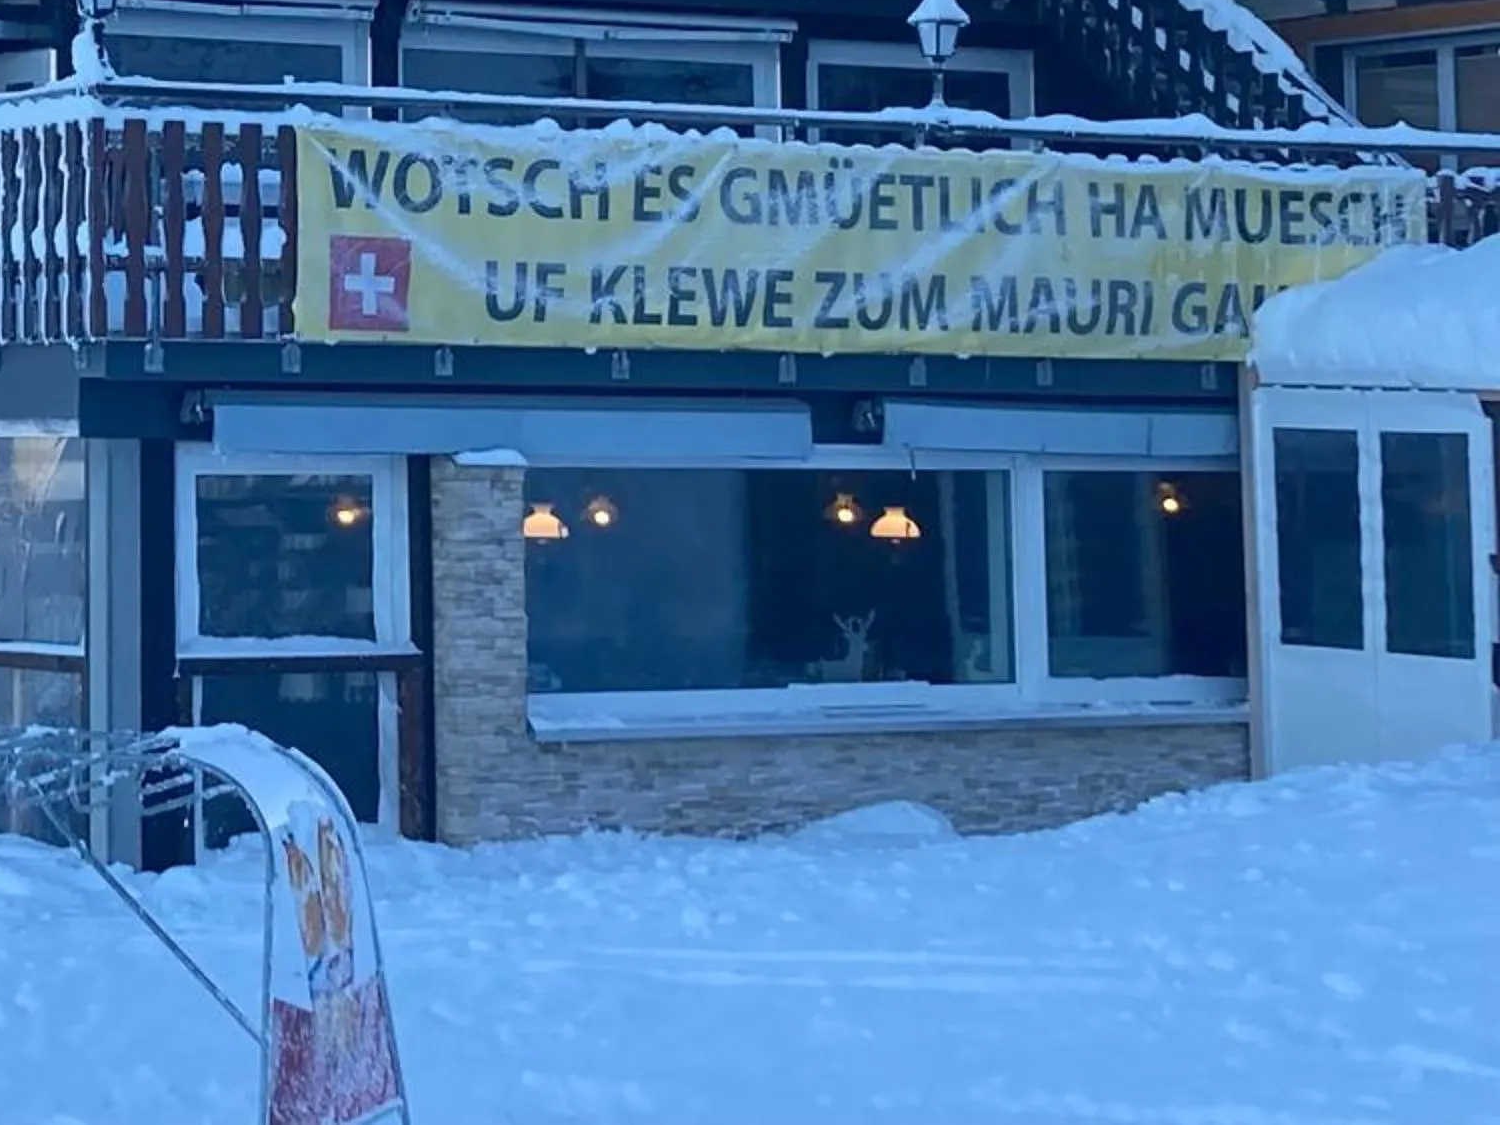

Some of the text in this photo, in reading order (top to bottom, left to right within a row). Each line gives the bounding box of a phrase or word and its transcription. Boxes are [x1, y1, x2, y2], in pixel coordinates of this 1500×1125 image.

[328, 148, 610, 221] WOTSCH
[633, 159, 699, 223] ES
[720, 158, 1066, 238] GMÜETLICH
[1090, 181, 1167, 240] HA
[484, 260, 567, 322] UF
[589, 265, 794, 328] KLEWE
[814, 270, 947, 332] ZUM
[972, 275, 1151, 335] MAURI
